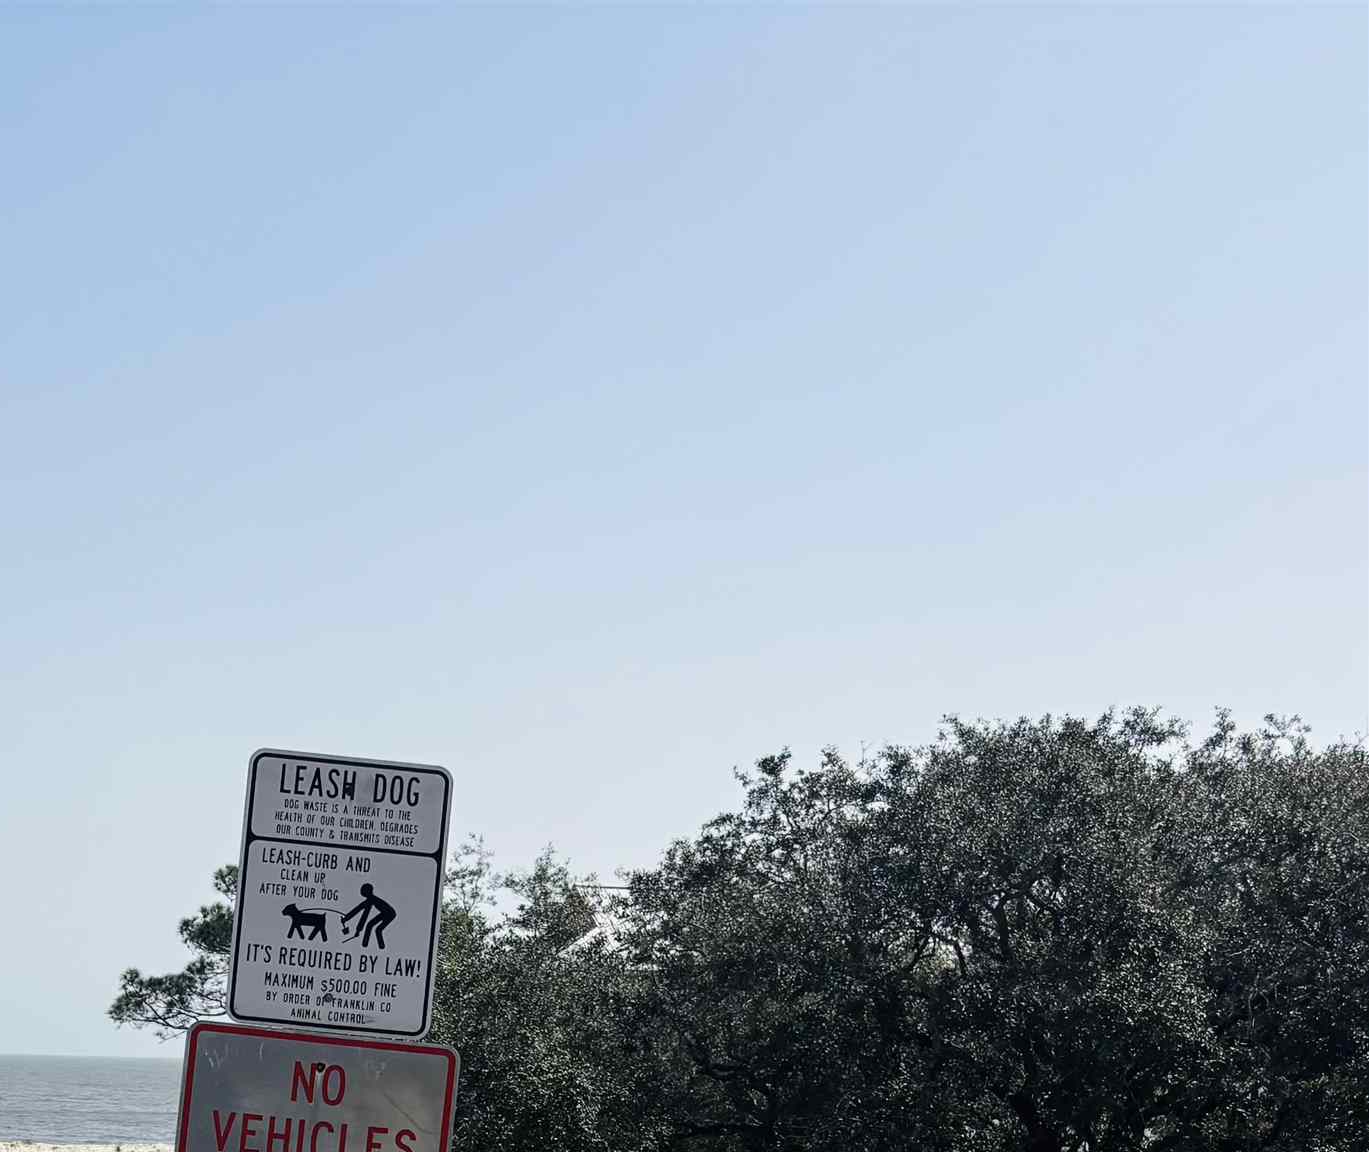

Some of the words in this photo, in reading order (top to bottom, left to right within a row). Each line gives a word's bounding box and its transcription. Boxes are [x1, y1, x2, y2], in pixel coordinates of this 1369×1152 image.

[280, 763, 357, 801] LEASH
[372, 773, 420, 807] DOG
[284, 798, 299, 809] DOG
[304, 800, 327, 813] WASTE
[331, 803, 338, 813] IS
[343, 804, 348, 815] A
[353, 805, 380, 817] THREAT
[385, 808, 393, 819] TO
[398, 810, 411, 821] THE
[274, 811, 302, 823] HEALTH
[306, 814, 316, 824] OF
[320, 816, 335, 827] OUR
[380, 822, 418, 835] DEGRADES
[276, 824, 291, 835] OUR
[295, 825, 324, 839] COUNTY
[328, 829, 335, 839] &
[340, 830, 380, 843] TRANSMITS
[384, 834, 415, 847] DISEASE
[262, 847, 338, 869] LEASH-CURB
[345, 856, 371, 873] AND
[280, 868, 309, 882] CLEAN
[314, 872, 326, 883] UP
[259, 883, 287, 896] AFTER
[292, 886, 316, 899] YOUR
[321, 888, 339, 901] DOG
[246, 943, 272, 963] IT'S
[278, 947, 352, 971] REQUIRED
[359, 954, 378, 974] BY
[385, 957, 421, 978] LAW!
[264, 972, 314, 991] MAXIMUM
[320, 978, 368, 995] $500.00
[374, 982, 397, 998] FINE
[265, 991, 277, 1001] BY
[283, 992, 311, 1006] ORDER
[331, 997, 375, 1011] FRANKLIN
[380, 1002, 391, 1013] CO
[290, 1008, 321, 1021] ANIMAL
[327, 1011, 366, 1024] CONTROL
[290, 1060, 347, 1106] NO
